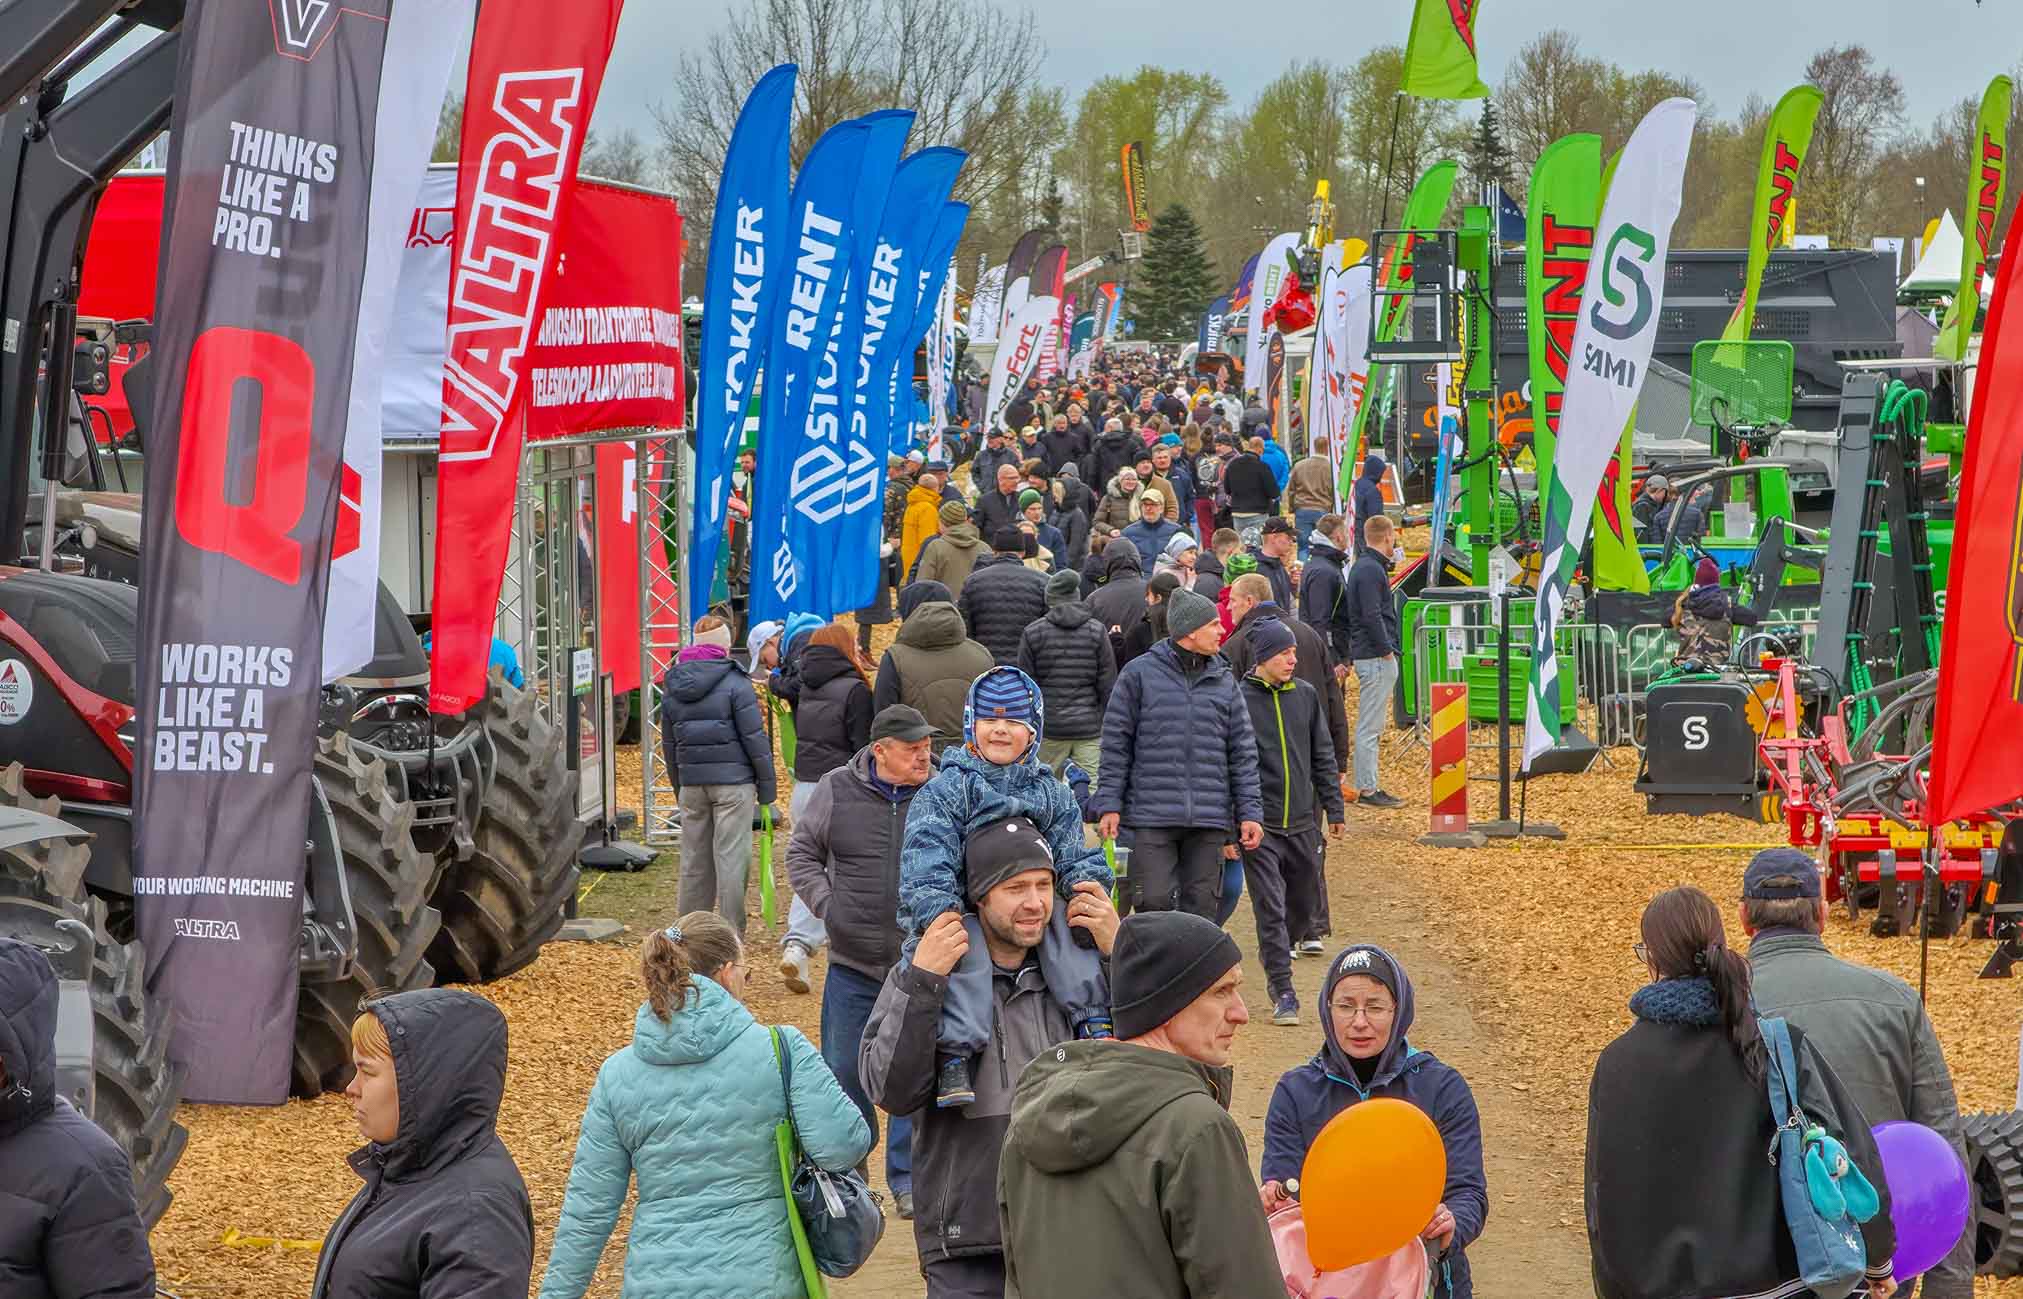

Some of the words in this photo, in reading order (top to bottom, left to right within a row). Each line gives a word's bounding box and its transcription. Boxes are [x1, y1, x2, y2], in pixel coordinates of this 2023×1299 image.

[229, 121, 337, 184] THINKS
[219, 167, 288, 216] LIKE
[290, 182, 310, 222] A
[212, 207, 281, 258] PRO.
[438, 67, 583, 461] VALTRA
[786, 201, 842, 350] RENT
[535, 307, 585, 346] ARUOSAD
[724, 205, 764, 452] TOKKER
[1583, 343, 1636, 388] SAMI
[173, 326, 315, 585] Q
[162, 643, 293, 687] WORKS
[158, 687, 235, 727] LIKE
[240, 689, 263, 728] A
[154, 731, 274, 774] BEAST.
[229, 877, 295, 898] MACHINE
[175, 918, 240, 940] ALTRA
